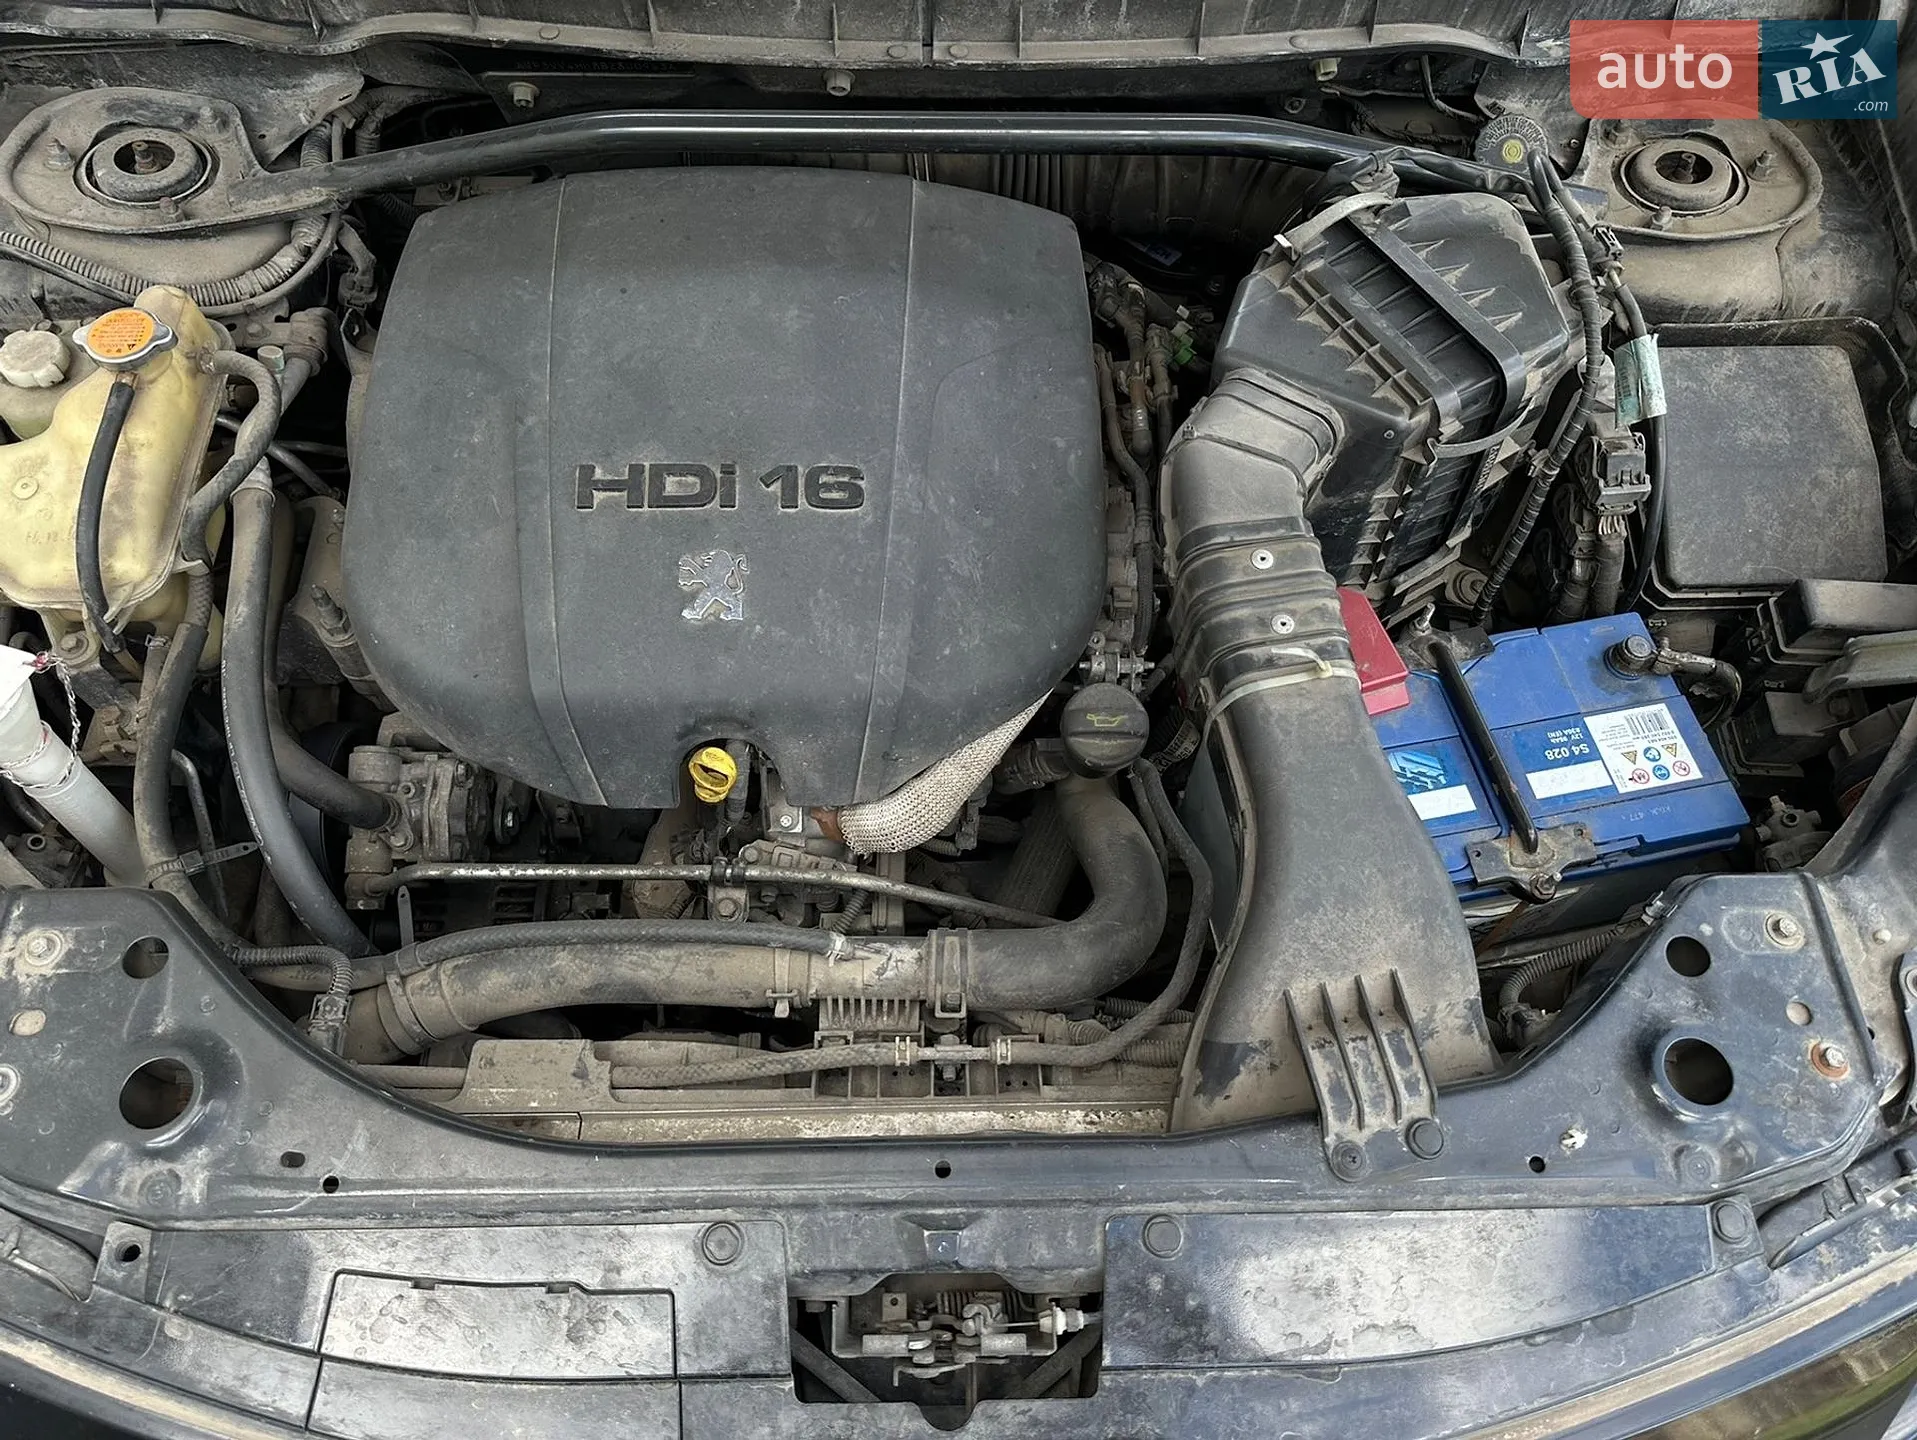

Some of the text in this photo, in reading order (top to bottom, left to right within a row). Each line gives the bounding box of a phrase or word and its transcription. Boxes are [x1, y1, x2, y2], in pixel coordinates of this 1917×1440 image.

[575, 463, 865, 510] HDi 16
[1544, 746, 1570, 760] 028
[1571, 743, 1590, 756] S4
